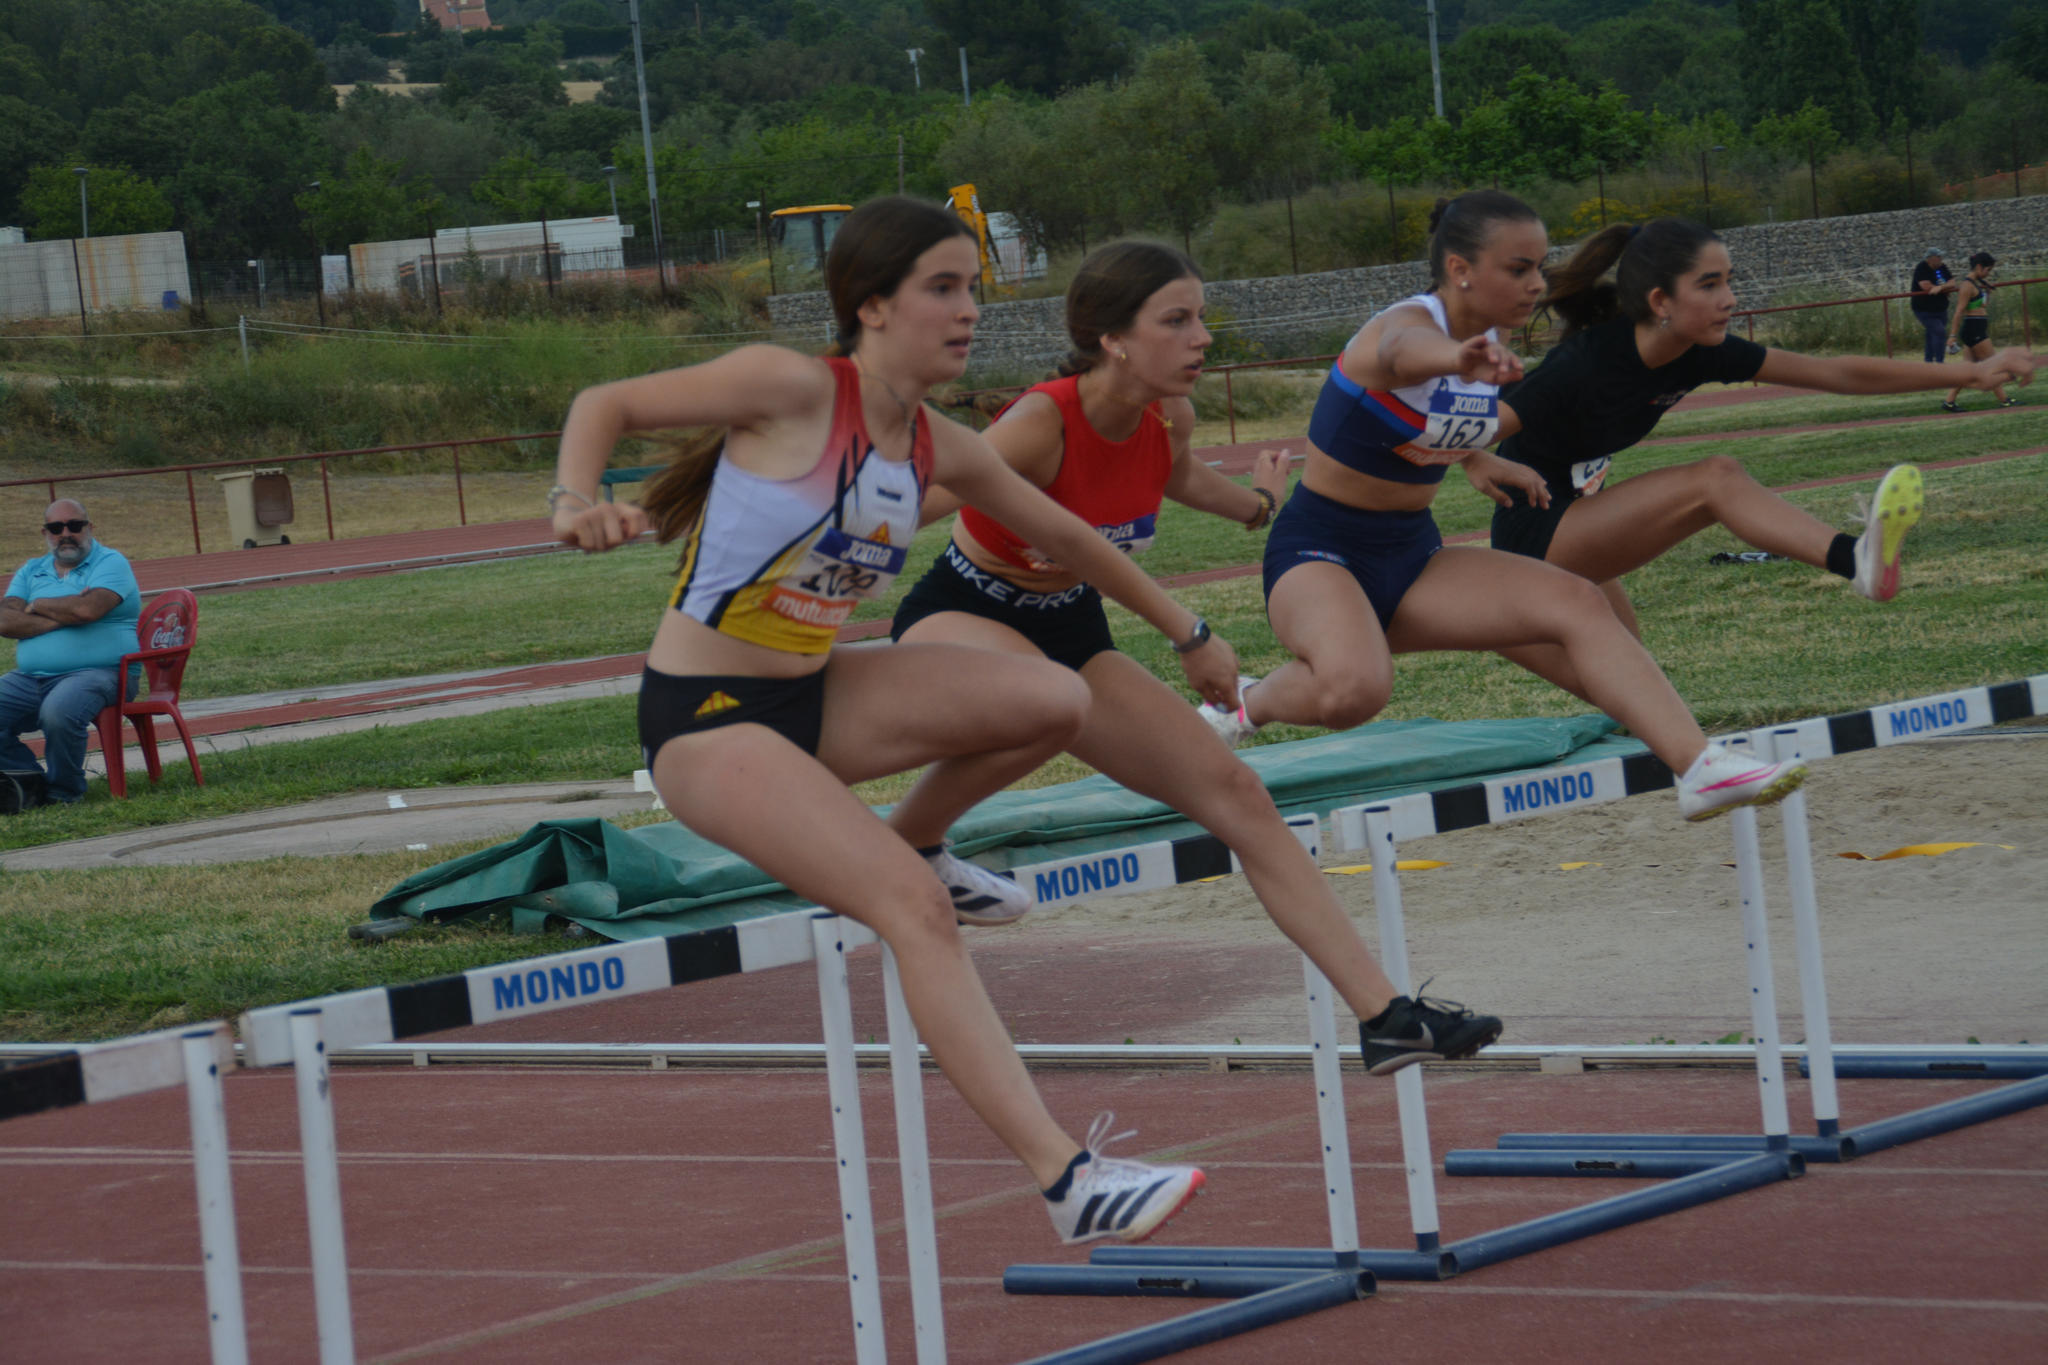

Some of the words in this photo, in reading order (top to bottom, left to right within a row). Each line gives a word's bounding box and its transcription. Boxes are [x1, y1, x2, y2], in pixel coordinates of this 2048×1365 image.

[1429, 418, 1486, 449] 162
[946, 545, 1014, 601] NIKE
[1015, 584, 1083, 609] PRO
[1890, 698, 1967, 736] MONDO
[1503, 771, 1593, 813] MONDO
[1036, 853, 1139, 903] MONDO
[493, 957, 624, 1010] MONDO
